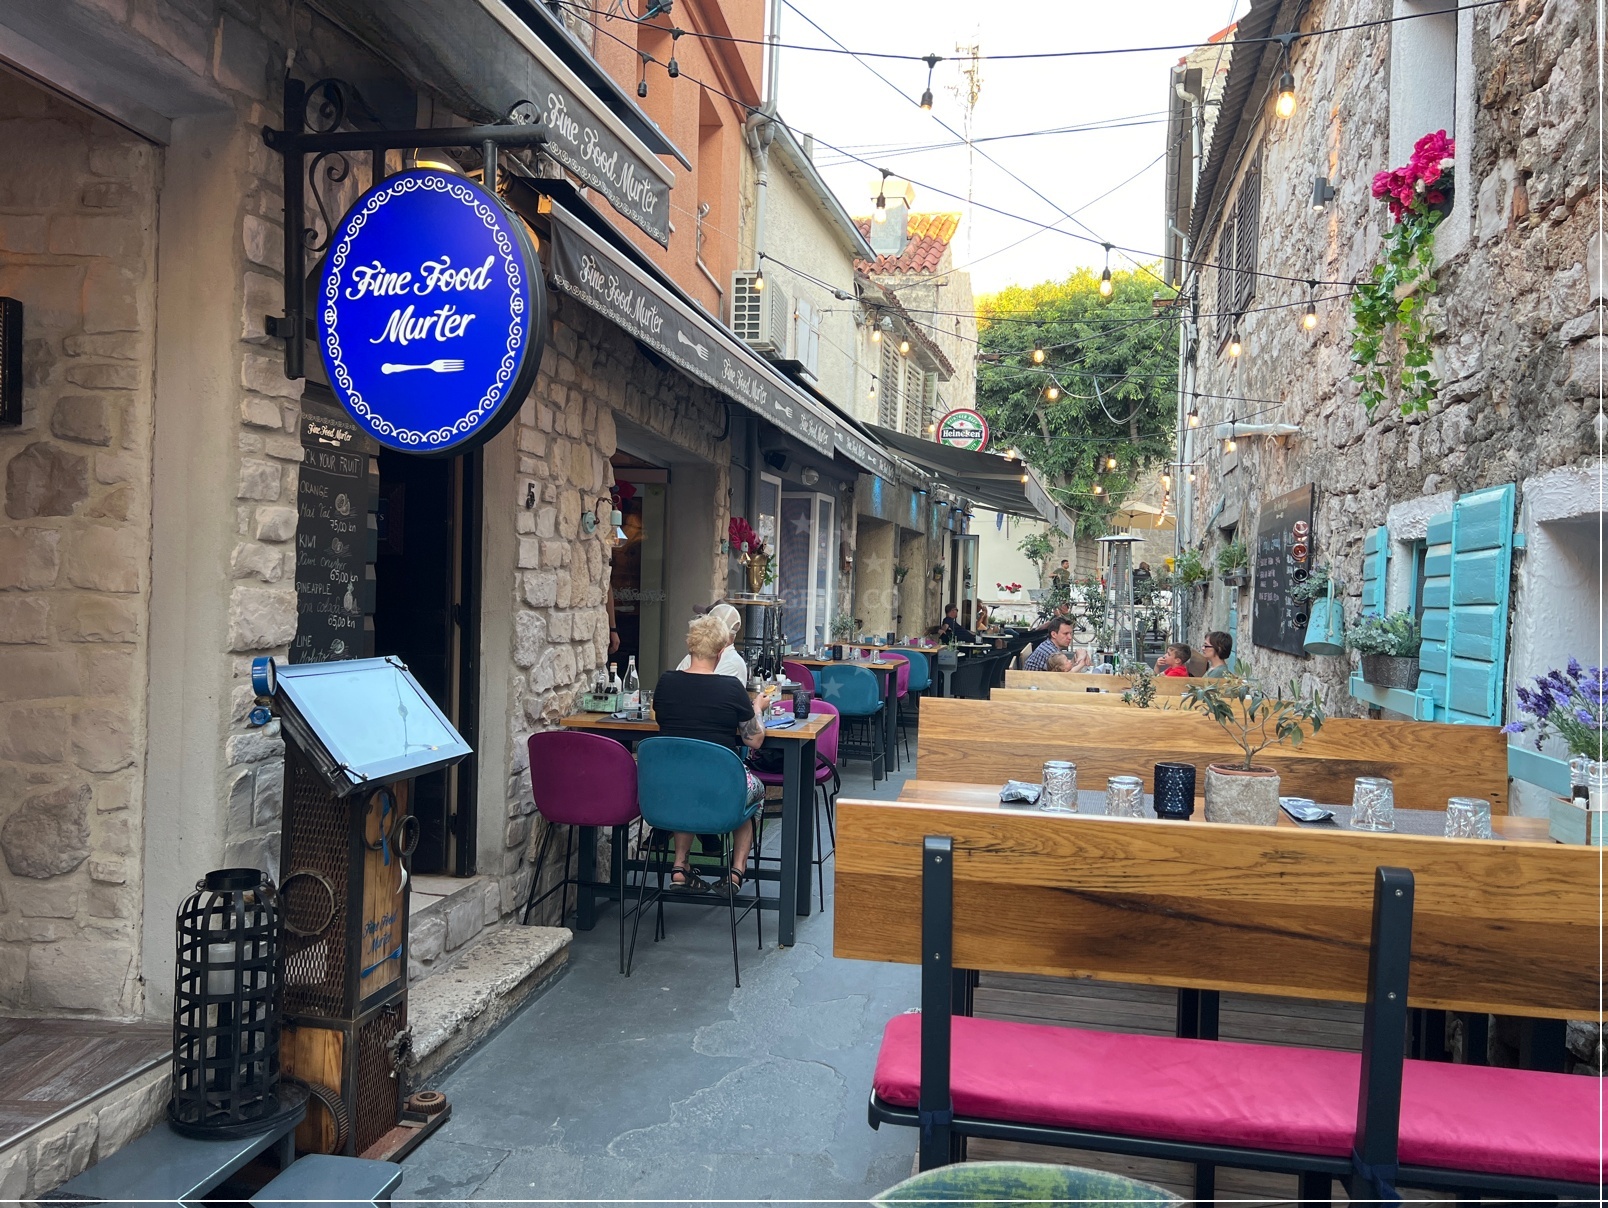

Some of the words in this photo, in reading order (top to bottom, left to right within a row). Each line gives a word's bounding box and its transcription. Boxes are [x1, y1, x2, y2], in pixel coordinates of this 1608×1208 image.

[544, 92, 578, 145] Fine
[580, 127, 618, 180] Food
[614, 162, 658, 214] Murter
[346, 260, 412, 300] Fine
[414, 255, 495, 296] Food
[580, 255, 604, 292] Fine
[605, 275, 634, 314] Food
[630, 296, 663, 334] Murter
[370, 304, 476, 346] Murter
[722, 358, 736, 384] Fine
[736, 370, 752, 398] Food
[749, 379, 768, 404] Murter
[308, 422, 320, 434] Fine
[320, 425, 334, 438] Food
[333, 430, 352, 441] Murter
[942, 430, 980, 438] Heineken
[320, 453, 336, 472] YOUR
[340, 456, 360, 473] FRUIT
[300, 480, 328, 498] ORANGE
[526, 482, 536, 510] 5
[330, 520, 346, 534] 75,00
[299, 534, 316, 548] KIWI
[330, 568, 348, 584] 65,00
[296, 582, 332, 595] PINEAPPLE
[296, 635, 312, 648] LIME
